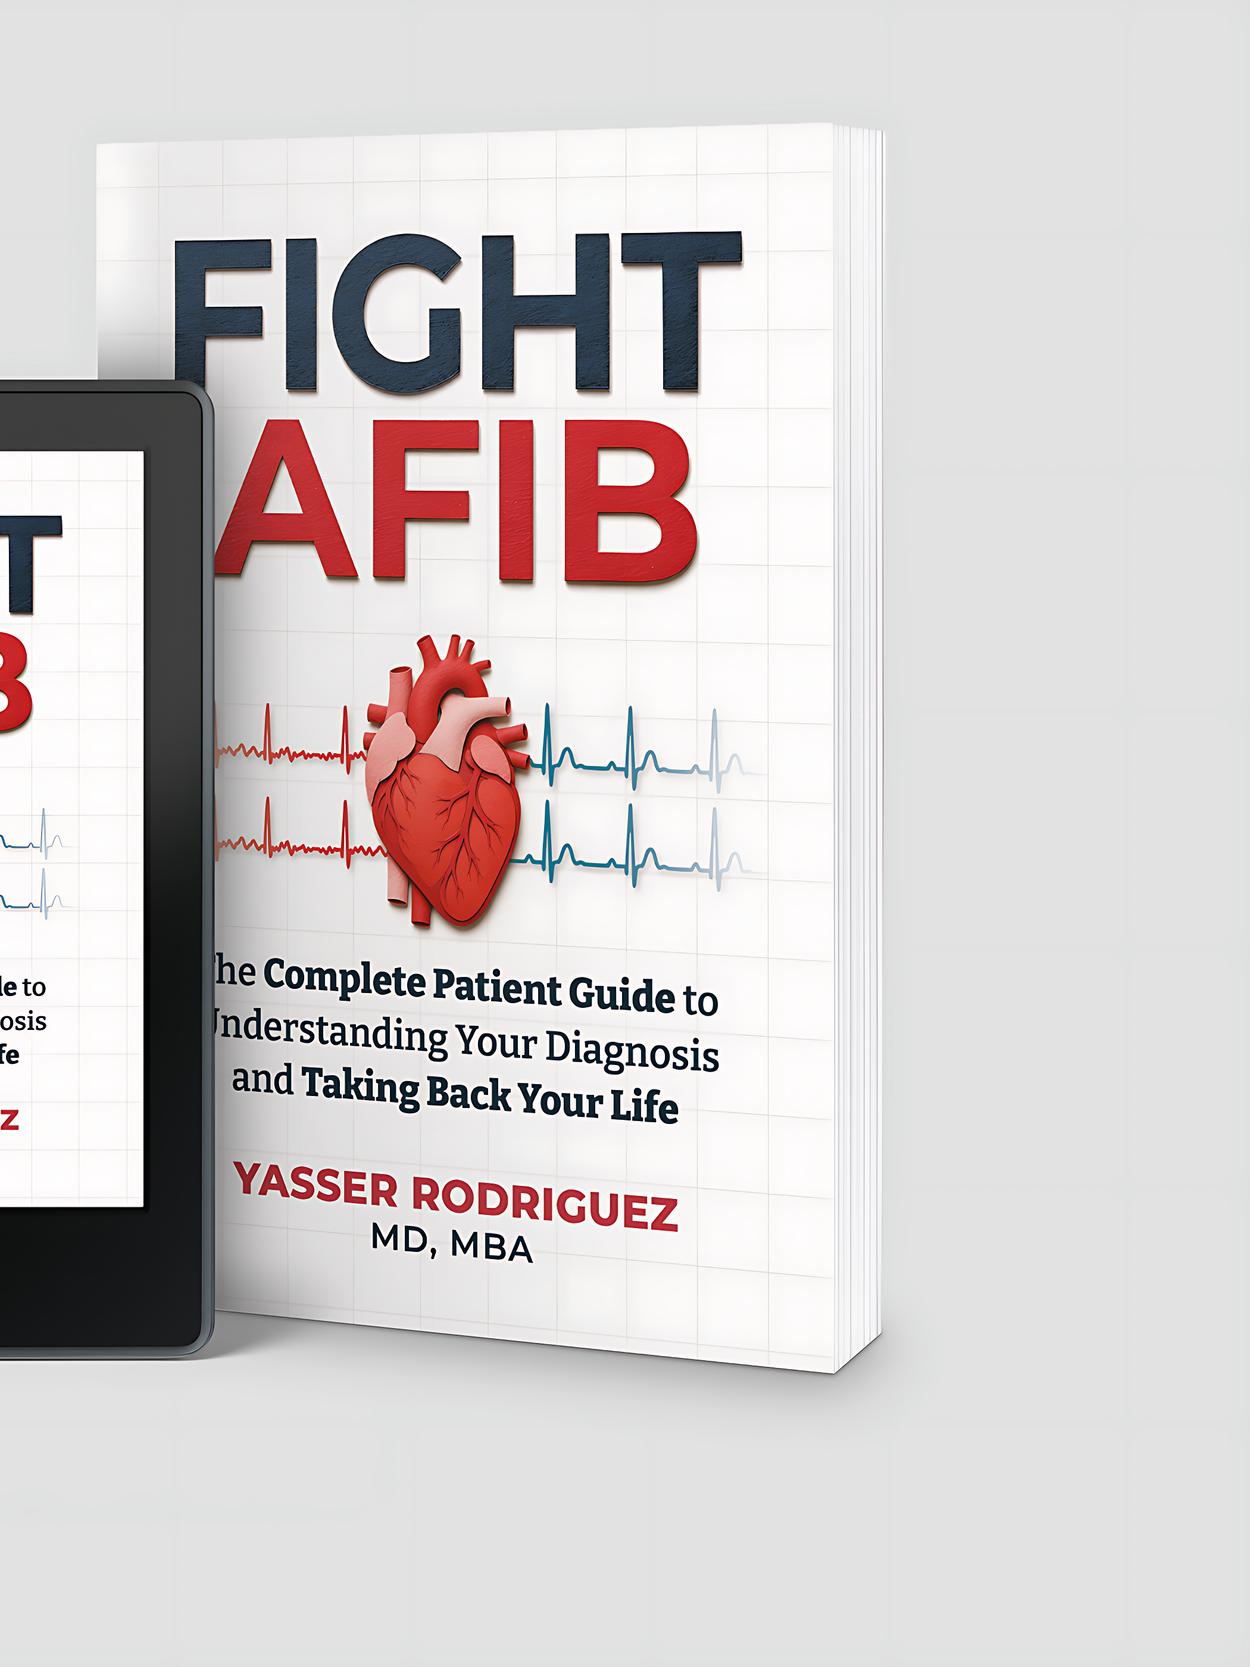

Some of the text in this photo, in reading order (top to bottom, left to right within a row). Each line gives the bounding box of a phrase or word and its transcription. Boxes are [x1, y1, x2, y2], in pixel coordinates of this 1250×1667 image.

[174, 230, 743, 393] FIGHT
[214, 418, 699, 582] AFIB
[21, 978, 47, 997] to
[214, 951, 719, 1017] he Complete Patient Guide to
[214, 1007, 720, 1076] nderstanding Your Diagnosis
[232, 1062, 679, 1125] and Taking Back Your Life
[232, 1160, 679, 1233] YASSER RODRIGUEZ
[372, 1221, 534, 1264] MD, MBA
